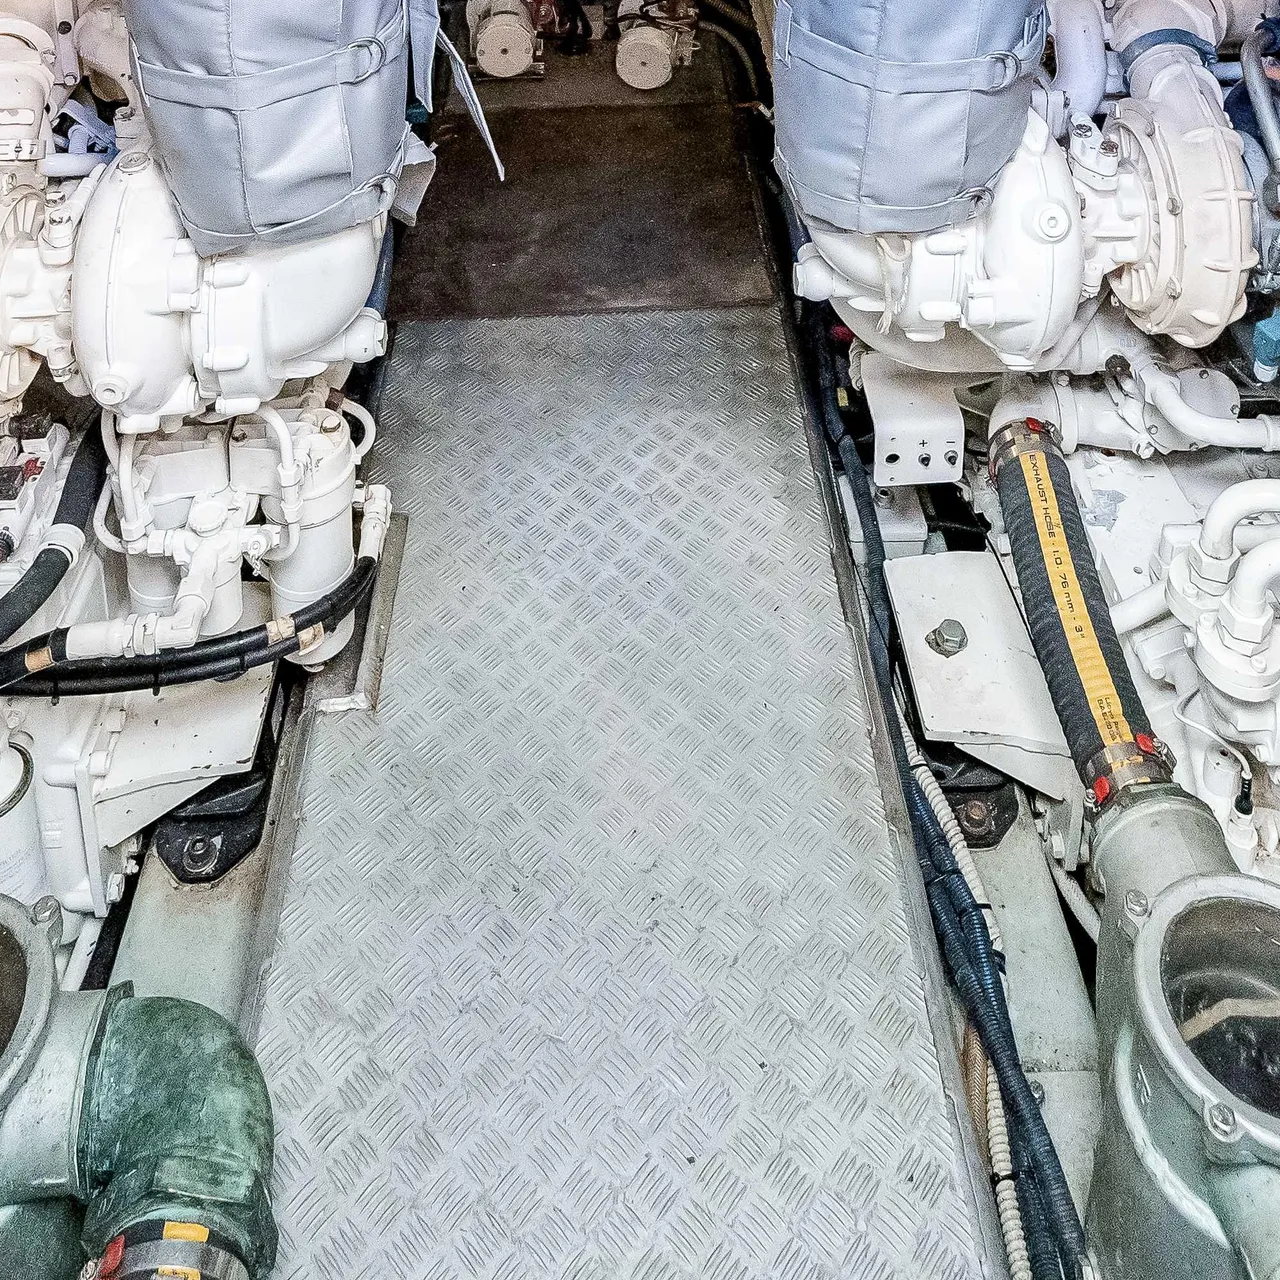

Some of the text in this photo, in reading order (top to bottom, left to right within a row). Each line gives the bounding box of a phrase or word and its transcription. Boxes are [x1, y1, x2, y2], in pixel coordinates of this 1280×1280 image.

[1029, 454, 1048, 504] EXHAUST
[1042, 507, 1056, 539] HOSE
[1059, 573, 1069, 589] 76
[1064, 592, 1075, 614] mm
